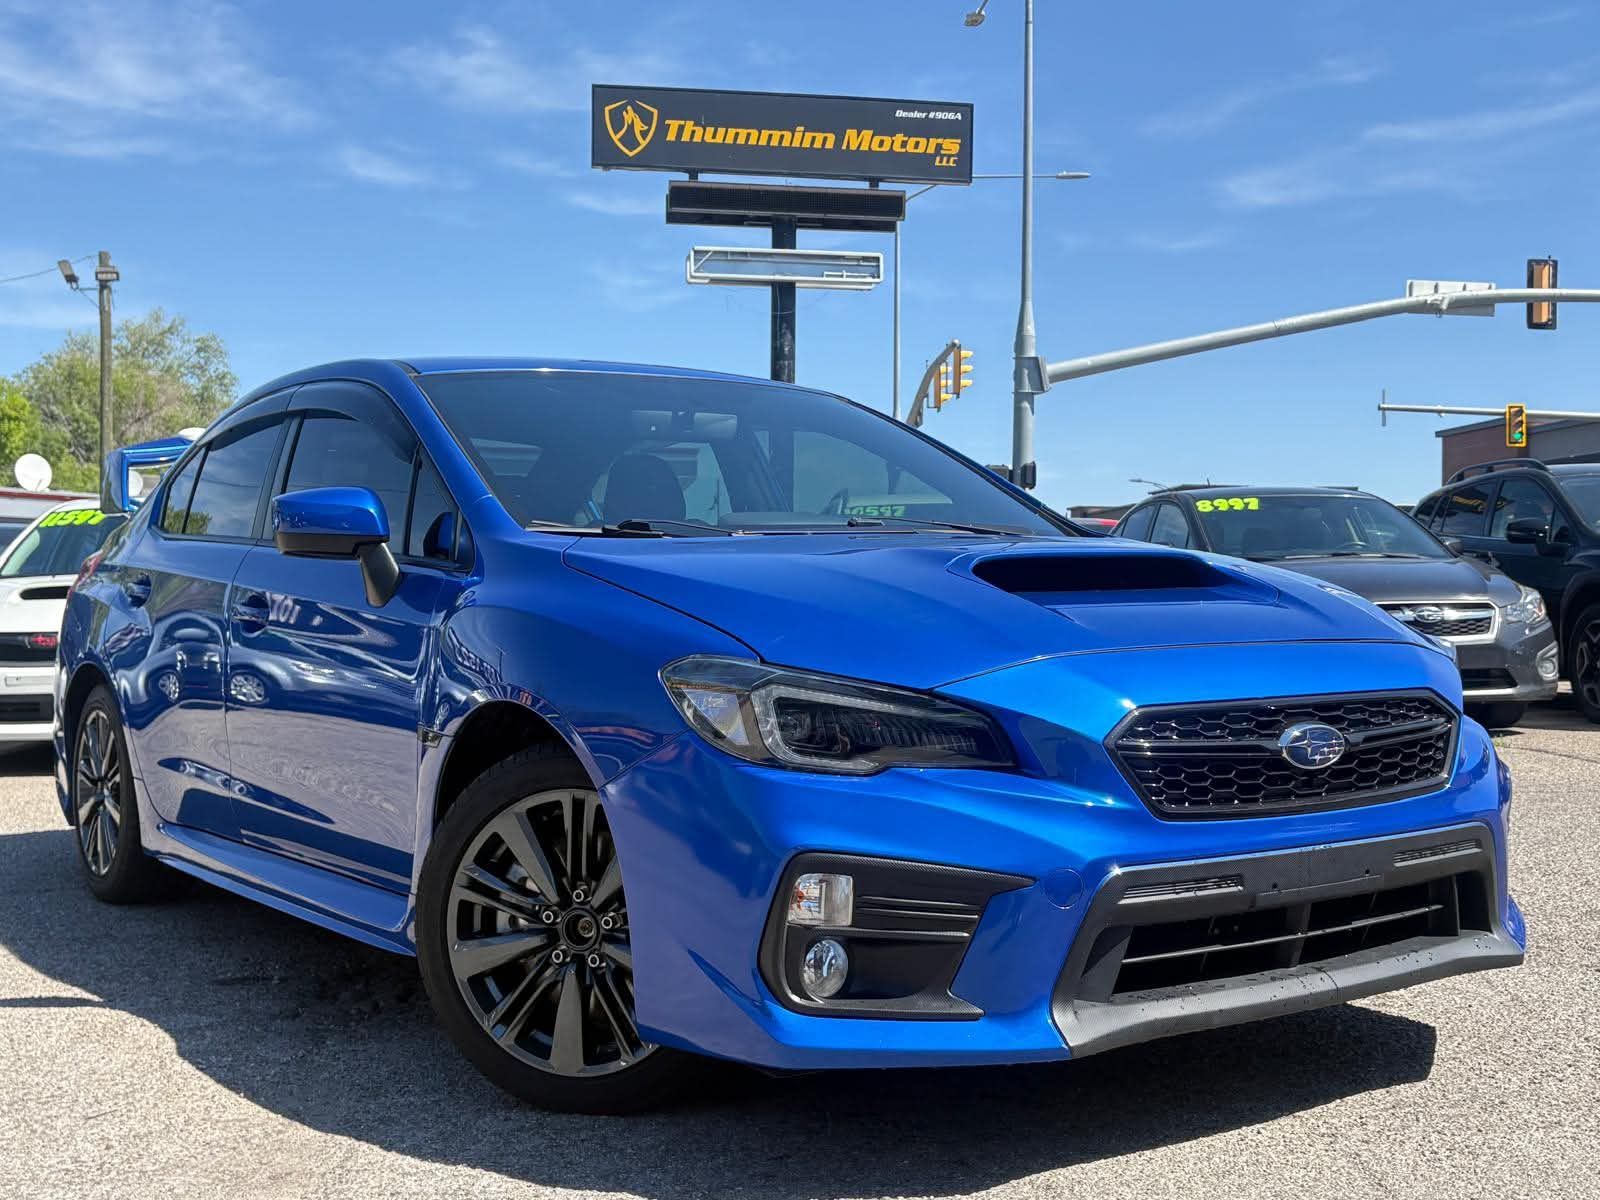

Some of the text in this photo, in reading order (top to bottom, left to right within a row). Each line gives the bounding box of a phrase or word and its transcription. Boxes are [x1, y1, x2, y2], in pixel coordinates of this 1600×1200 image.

[895, 109, 962, 121] Dealer #906A
[664, 119, 961, 155] Thummim Motors
[934, 155, 958, 167] LLC
[1195, 497, 1260, 513] 8997
